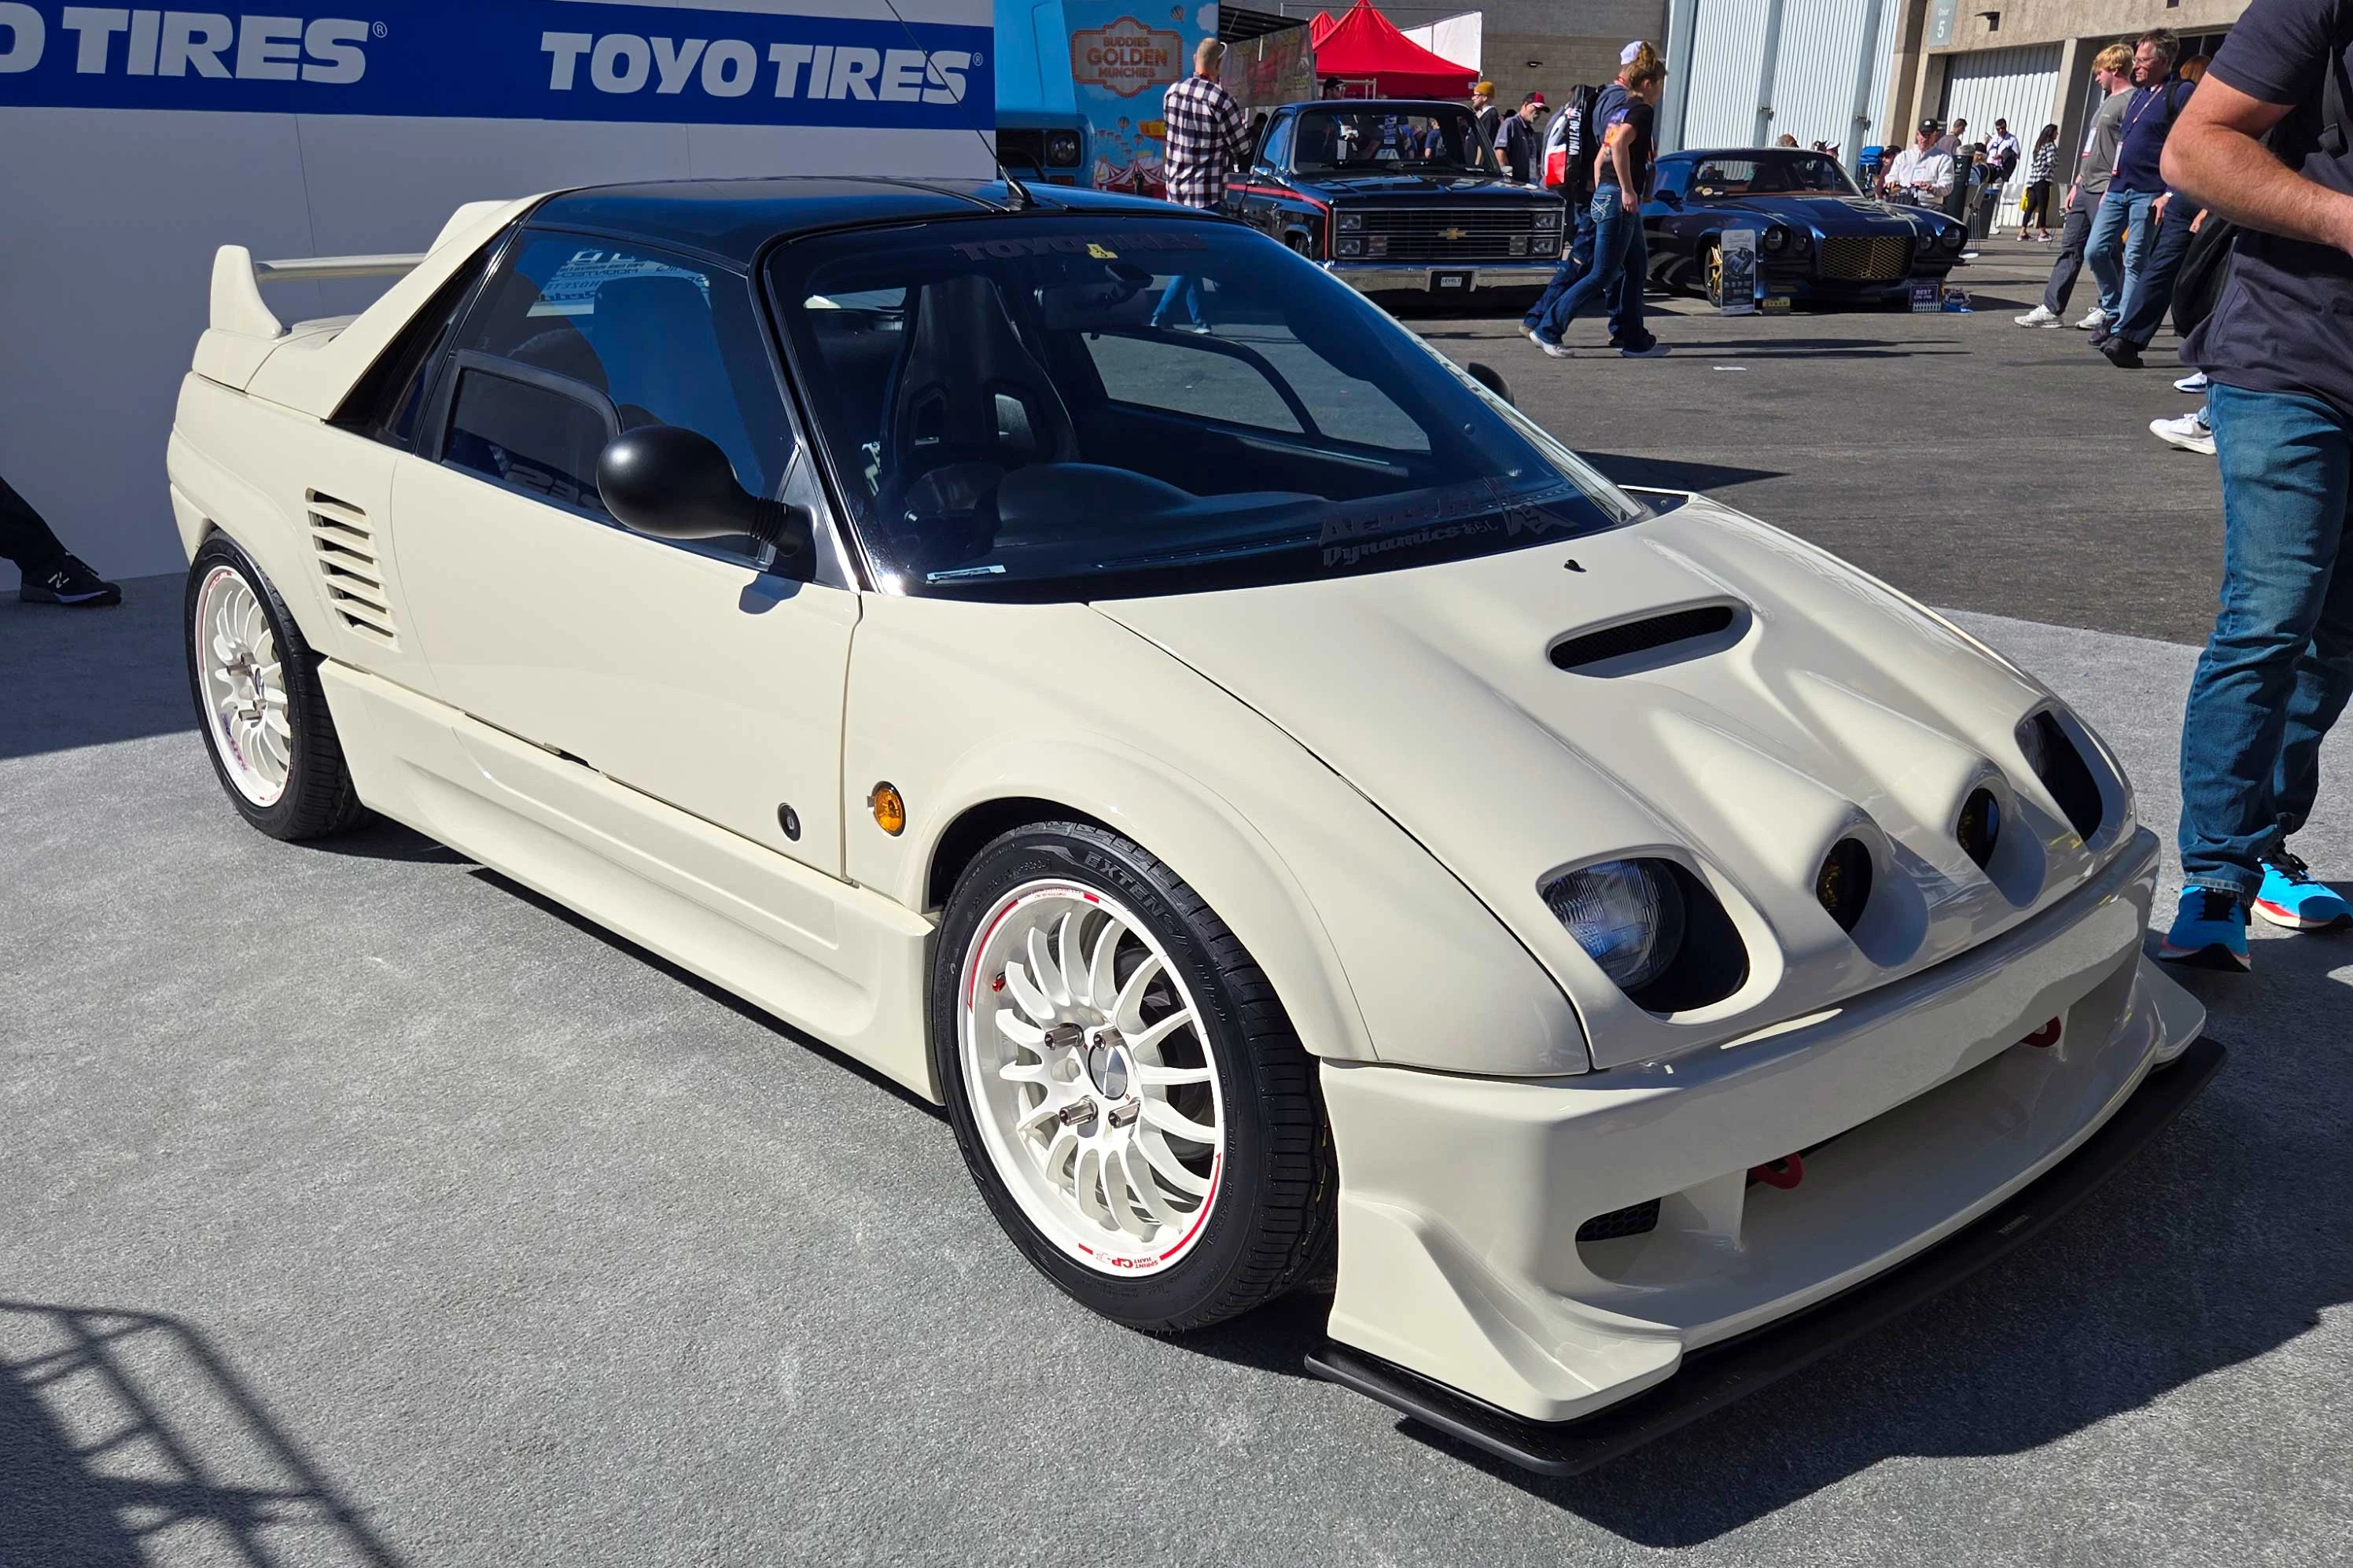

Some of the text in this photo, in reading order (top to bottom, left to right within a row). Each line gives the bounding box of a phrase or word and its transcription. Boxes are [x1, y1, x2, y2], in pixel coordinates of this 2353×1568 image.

[1937, 20, 1946, 39] 5
[1103, 36, 1151, 48] BUDDIES
[540, 31, 758, 98] TOYO
[1086, 47, 1169, 67] GOLDEN
[1097, 67, 1156, 79] MUNCHIES
[1568, 120, 1580, 156] OPTIMA
[1320, 525, 1460, 568] Dynamics
[1134, 1260, 1159, 1269] SPRINT
